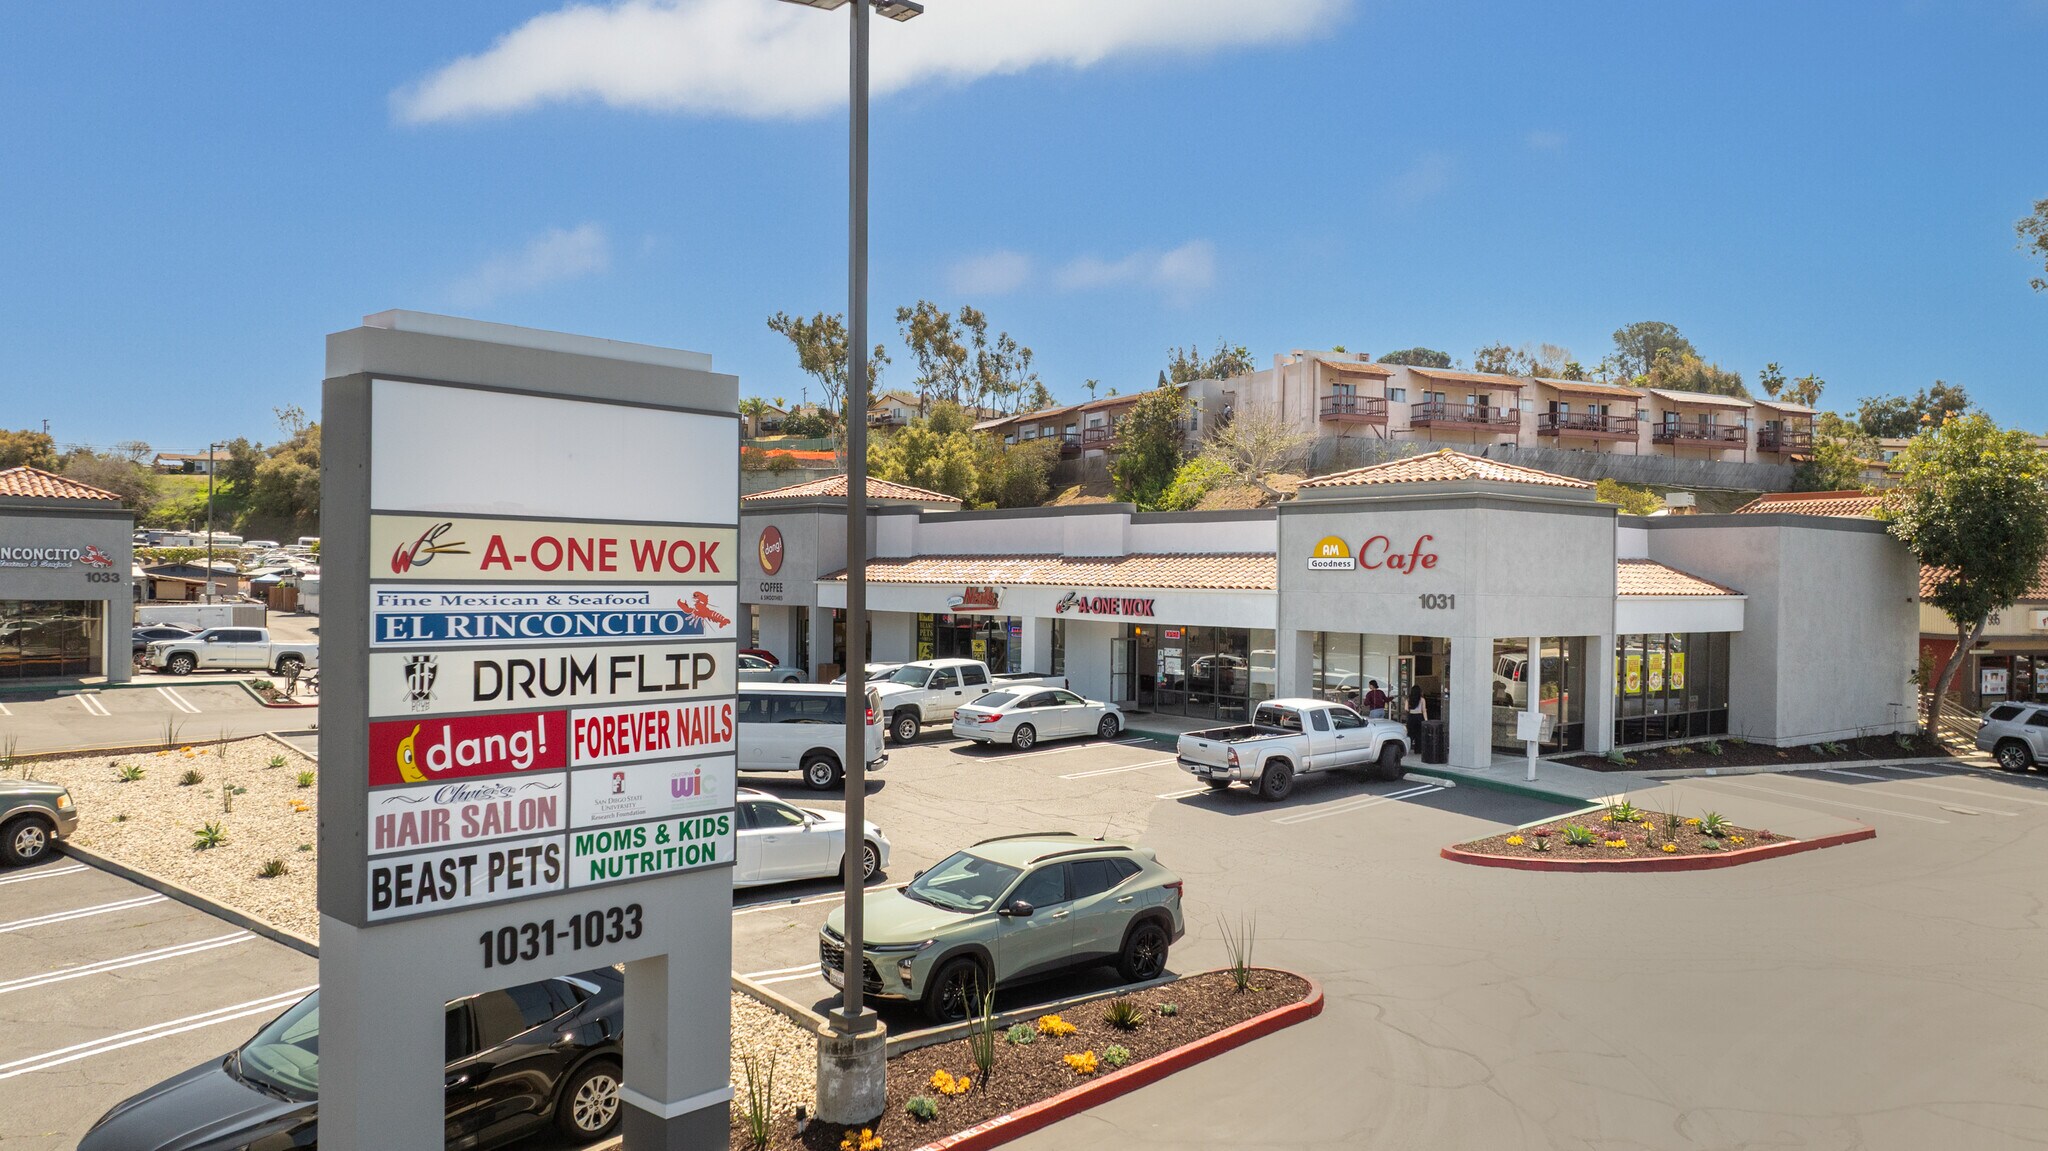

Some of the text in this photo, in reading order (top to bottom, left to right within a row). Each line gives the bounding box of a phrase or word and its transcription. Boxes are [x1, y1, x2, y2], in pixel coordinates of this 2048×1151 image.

[480, 535, 721, 574] A-ONE WOK
[1311, 560, 1351, 568] Goodness
[1359, 534, 1438, 575] Cafe
[85, 572, 120, 583] 1033
[760, 582, 783, 593] COFFEE
[377, 594, 651, 606] Fine Mexican & Seafood
[1079, 596, 1154, 616] A-ONE WOK
[1419, 594, 1455, 609] 1031
[383, 612, 684, 641] EL RINCONCITO
[474, 653, 716, 701] DRUM FLIP
[426, 715, 547, 770] dang!
[574, 703, 732, 760] FOREVER NAILS
[375, 795, 557, 850] HAIR SALON
[591, 809, 646, 821] Research Foundation
[601, 802, 636, 811] UNIVERSITY
[576, 815, 730, 857] MOMS & KIDS
[372, 843, 560, 912] BEAST PETS
[590, 842, 715, 881] NUTRITION
[480, 904, 643, 968] 1031-1033
